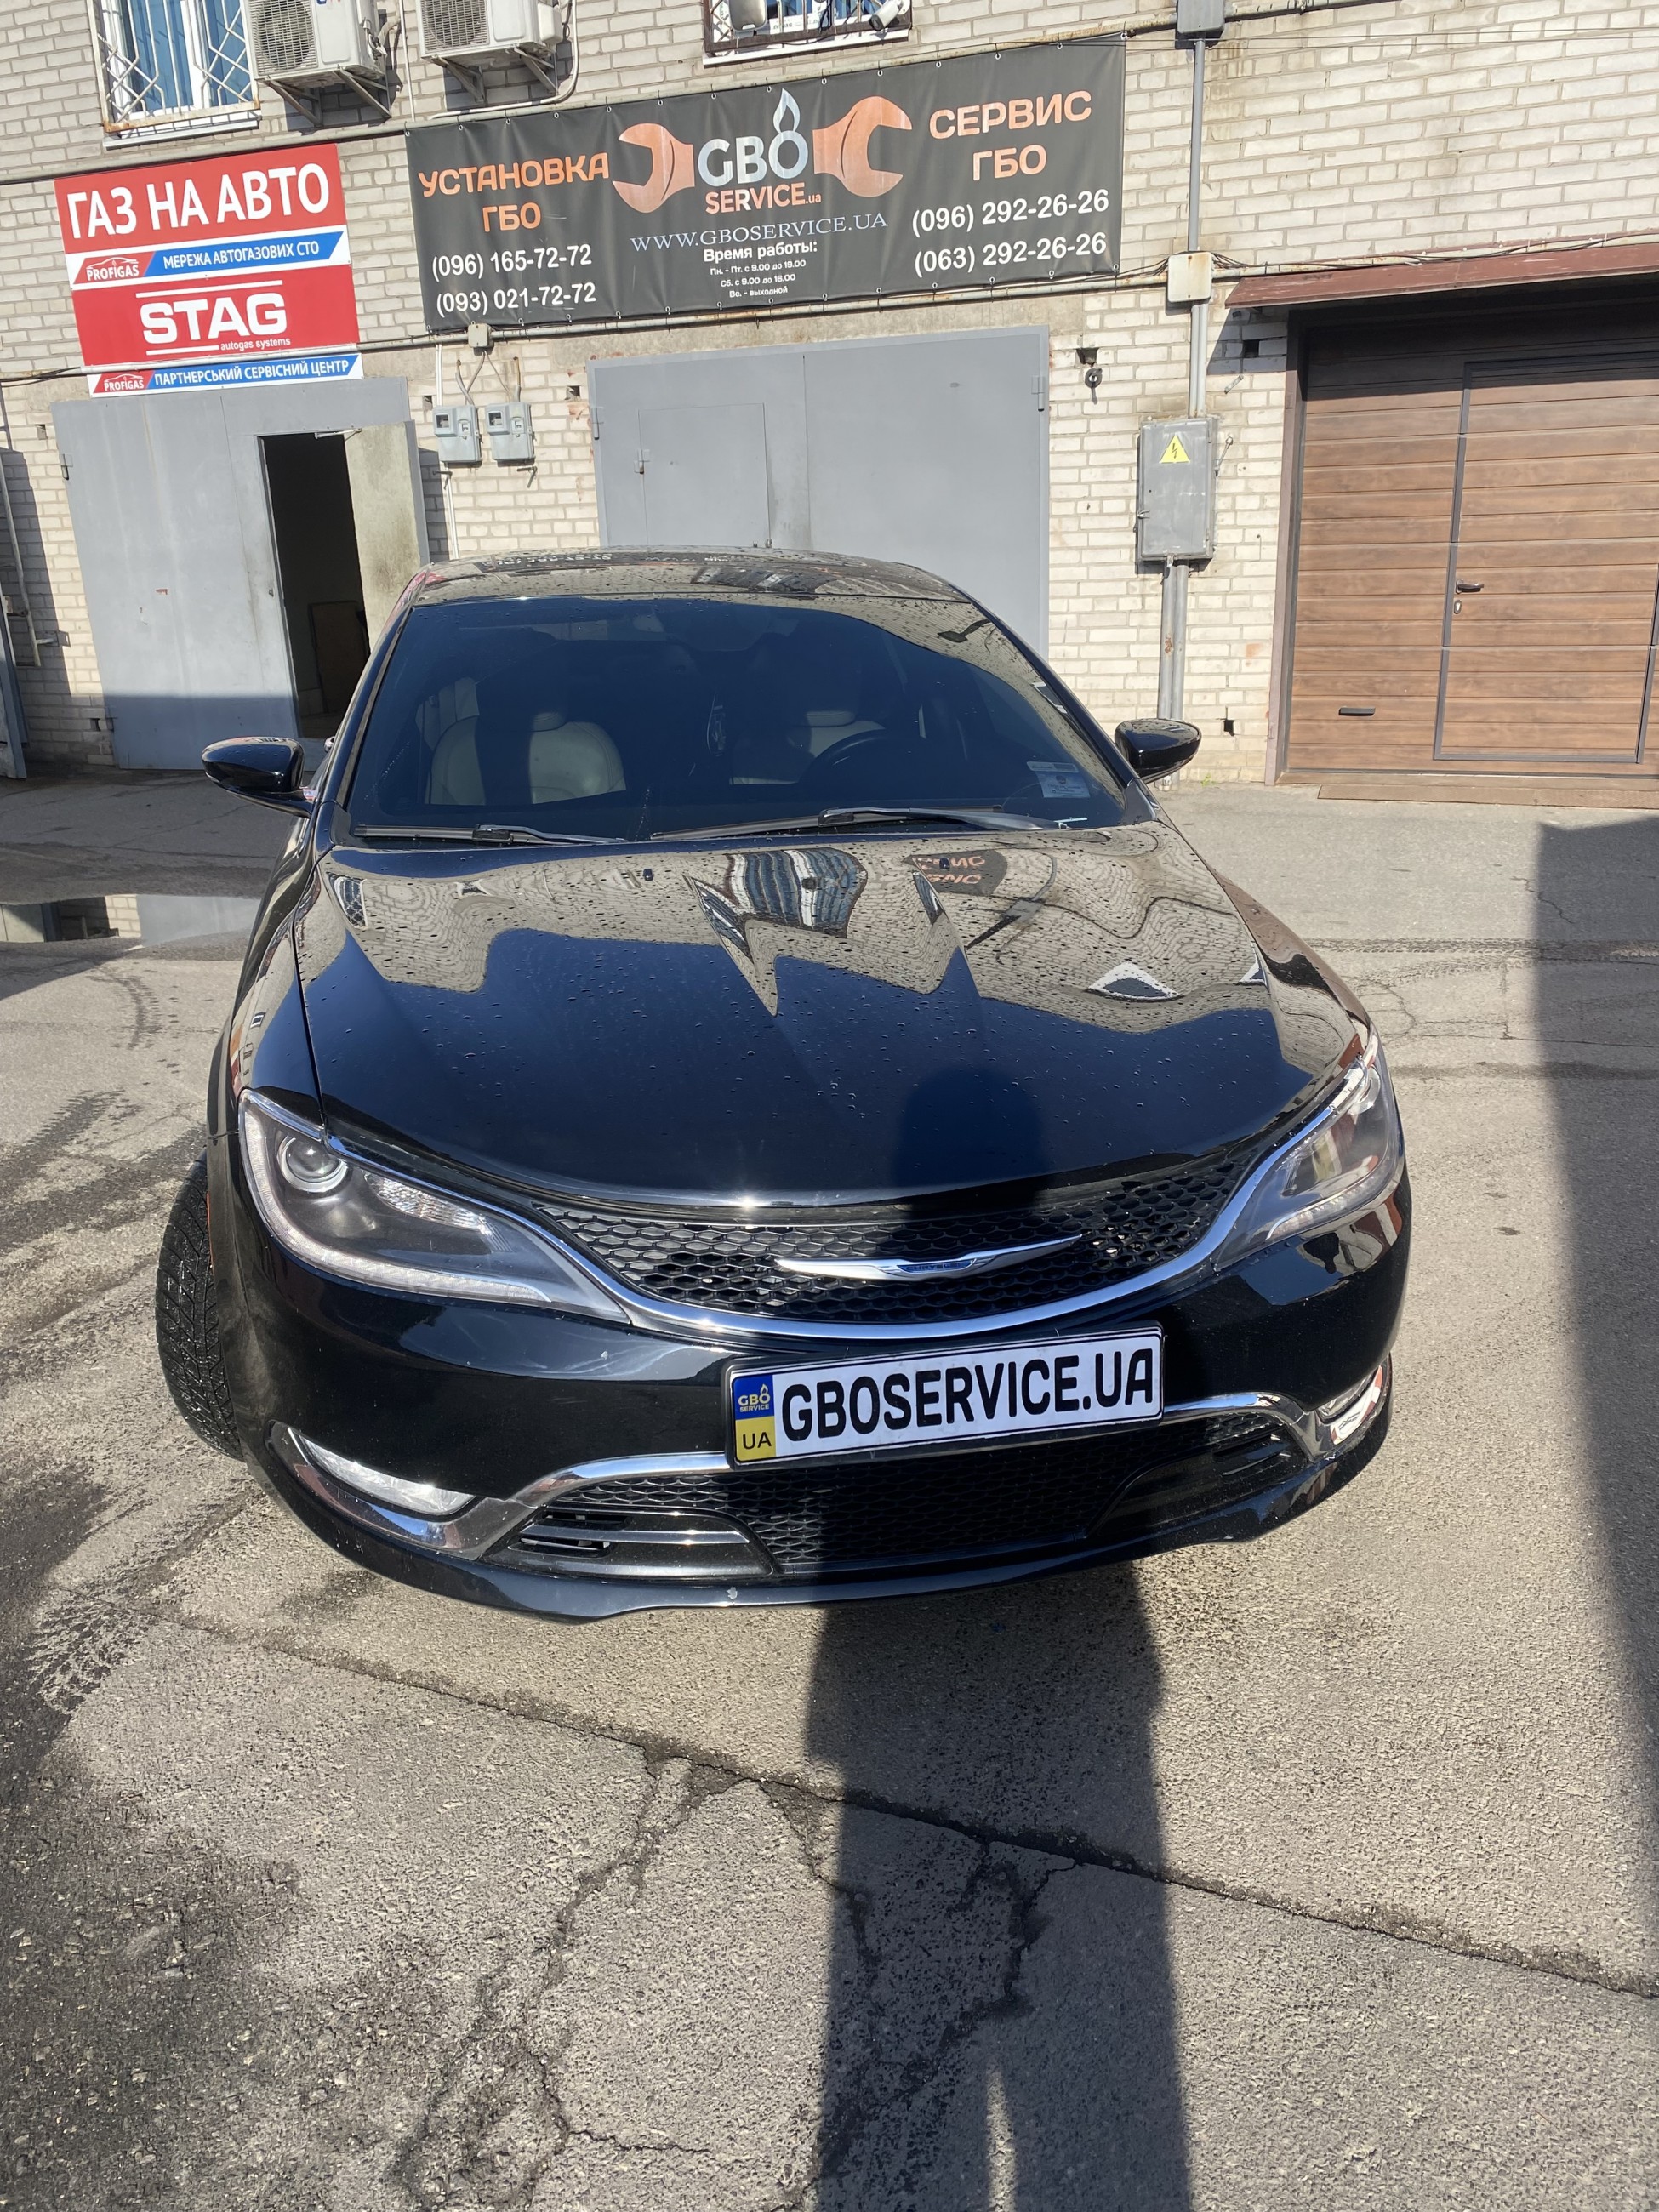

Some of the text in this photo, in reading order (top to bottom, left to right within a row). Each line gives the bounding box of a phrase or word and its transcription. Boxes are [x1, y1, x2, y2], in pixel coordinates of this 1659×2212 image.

[928, 90, 1092, 140] СЕРВИС
[698, 130, 808, 187] GBO
[972, 144, 1047, 181] ГБО
[418, 151, 610, 198] УСТАНОВКА
[66, 163, 329, 239] ГАЗ НА АВТО
[912, 189, 1109, 238] (096) 292-26-26
[482, 202, 541, 232] ГБО
[630, 213, 888, 252] WWW.GBOSERVICE.UA
[163, 241, 319, 269] МЕРЕЖА АВТОГАЗОВИХ СТО
[432, 243, 592, 282] (096) 165-72-72
[703, 241, 818, 264] Время работы:
[784, 259, 806, 268] 19.00
[915, 232, 1107, 278] (063) 292-26-26
[86, 265, 140, 281] PROFIGAS
[721, 279, 733, 288] Сб.
[436, 282, 596, 318] (093) 021-72-72
[750, 286, 788, 296] выходной
[140, 293, 287, 345] STAG
[220, 337, 291, 351] autogas systems
[104, 379, 145, 391] PROFIGAS
[154, 360, 349, 385] ПАРТНЕРСЬКИЙ СЕРВІСНИЙ ЦЕНТР
[738, 1393, 771, 1406] GBO
[739, 1404, 770, 1412] SERVICE
[781, 1348, 1153, 1441] GBOSERVICE.UA
[743, 1432, 772, 1450] UA
